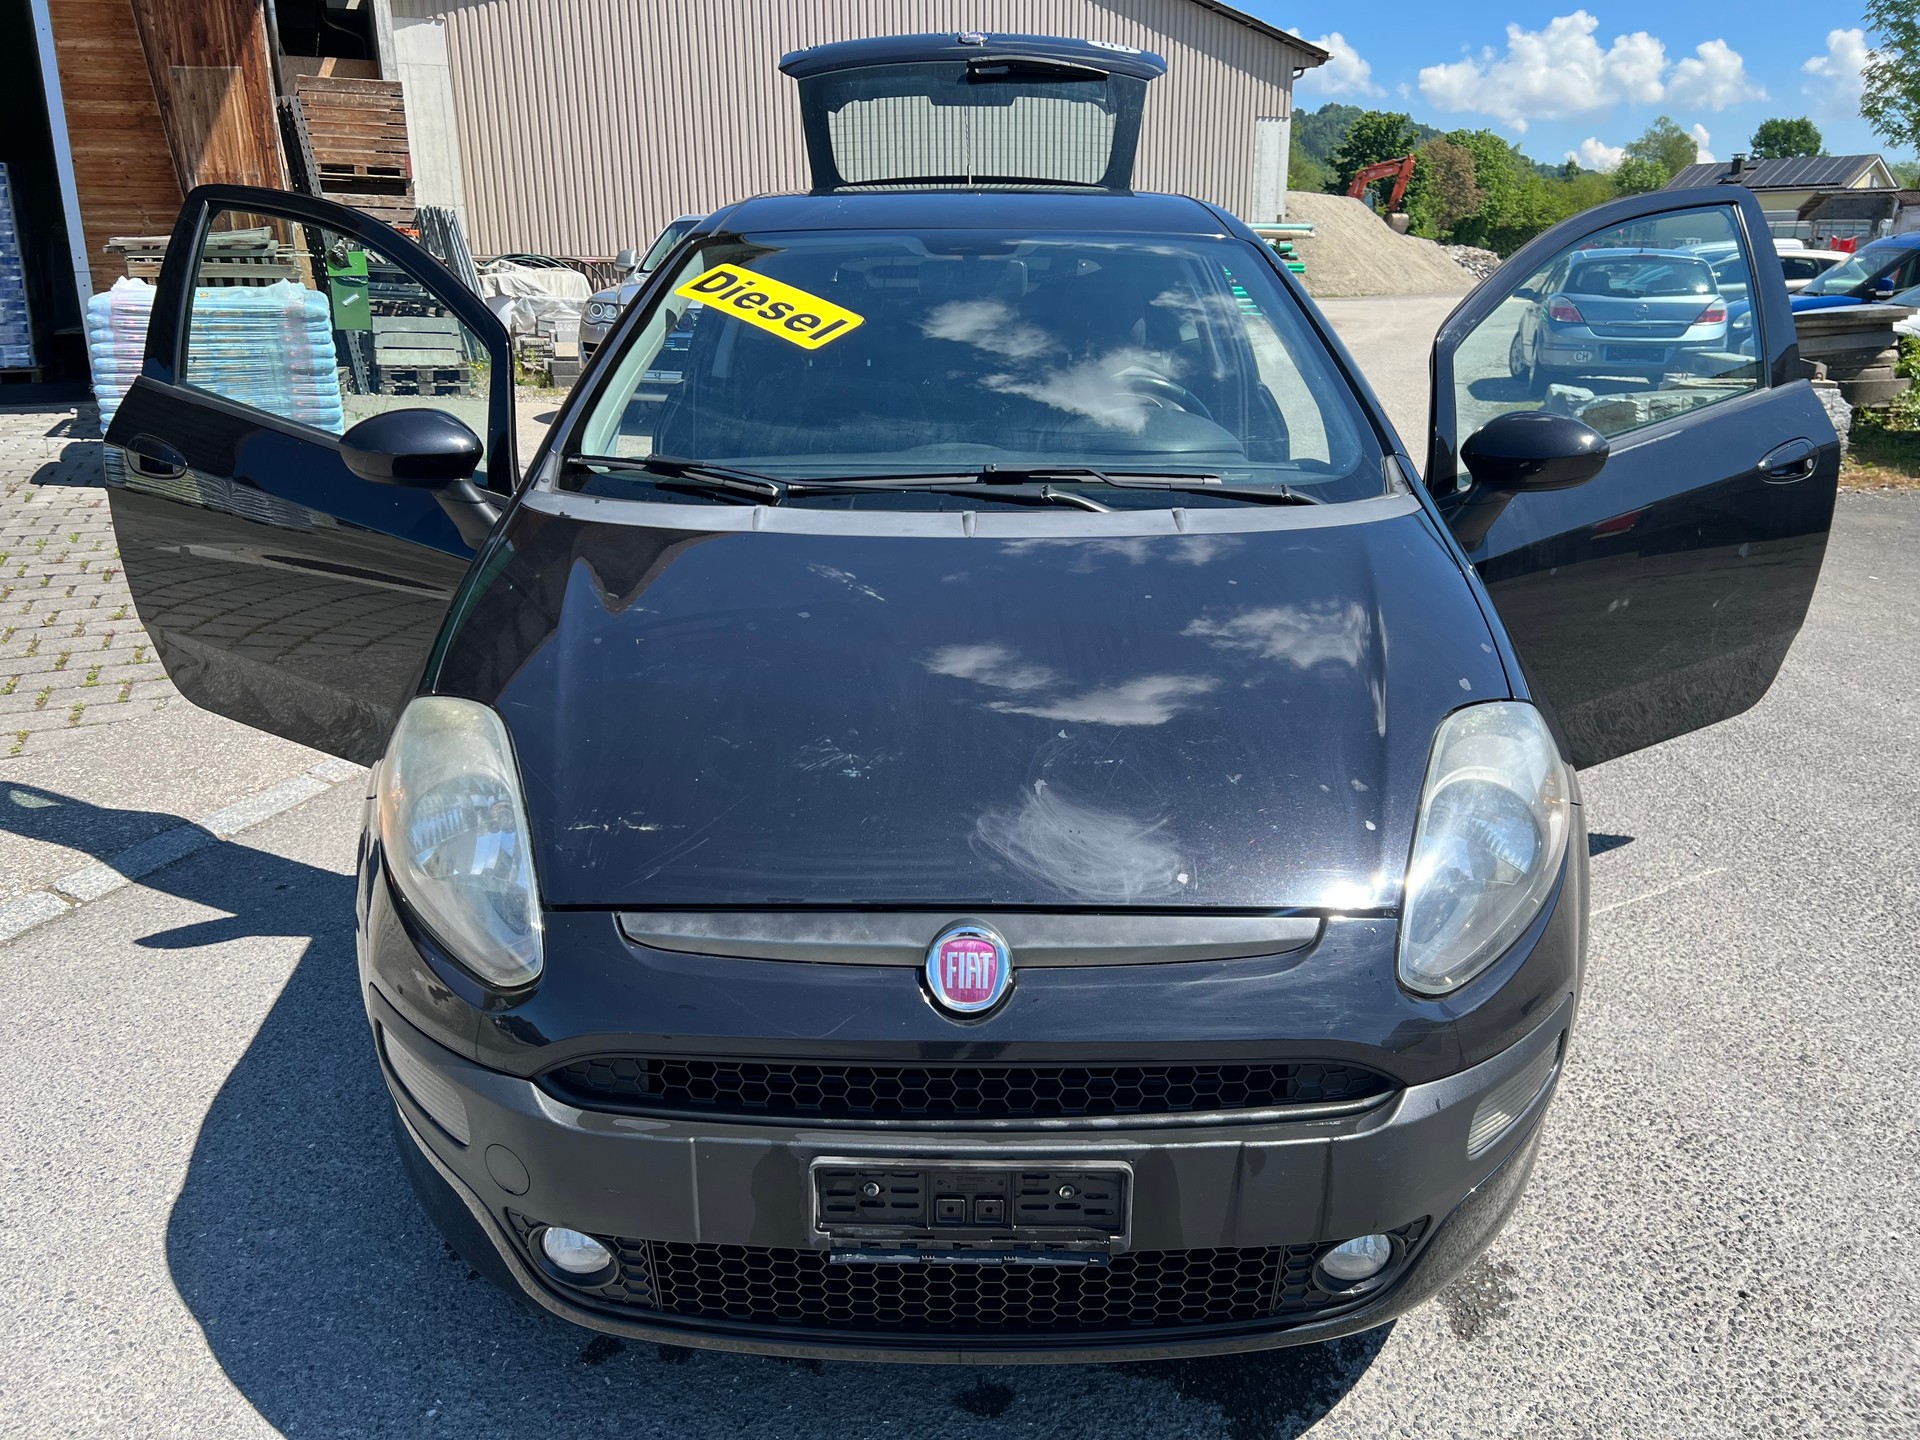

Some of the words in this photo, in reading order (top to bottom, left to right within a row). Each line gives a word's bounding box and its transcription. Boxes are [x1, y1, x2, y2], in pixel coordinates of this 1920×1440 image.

[690, 270, 848, 341] Diesel
[1575, 351, 1589, 361] CH
[946, 951, 993, 989] FIAT
